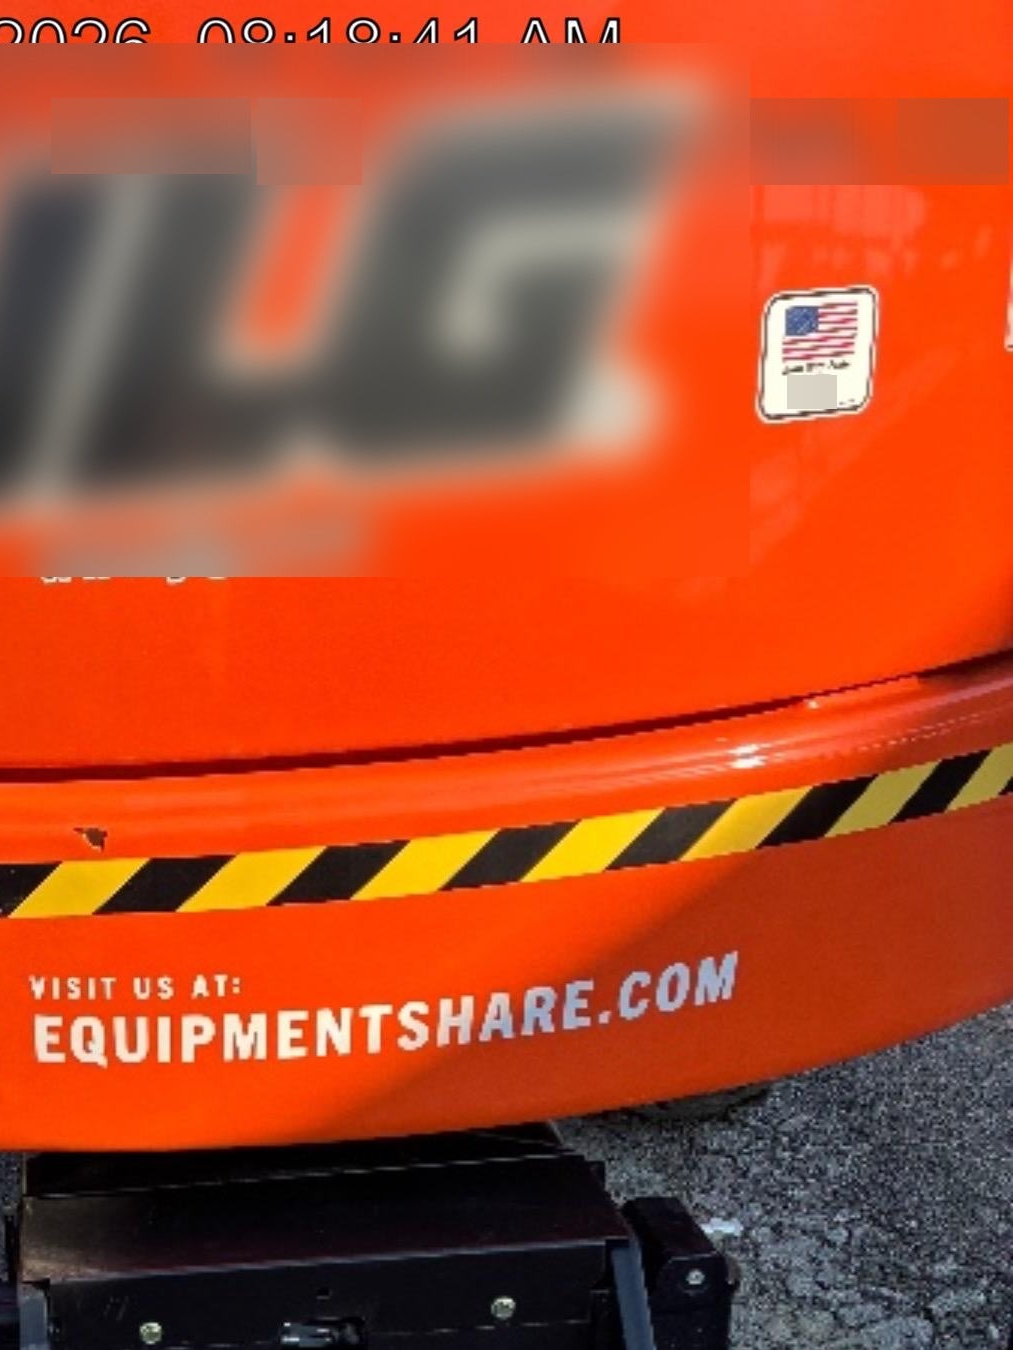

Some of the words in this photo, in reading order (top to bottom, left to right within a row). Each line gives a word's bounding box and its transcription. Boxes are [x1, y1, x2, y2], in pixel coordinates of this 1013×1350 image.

[28, 974, 117, 1001] VISIT
[132, 977, 175, 1001] US
[191, 973, 240, 999] AT:
[33, 950, 738, 1069] EQUIPMENTSHARE.COM
